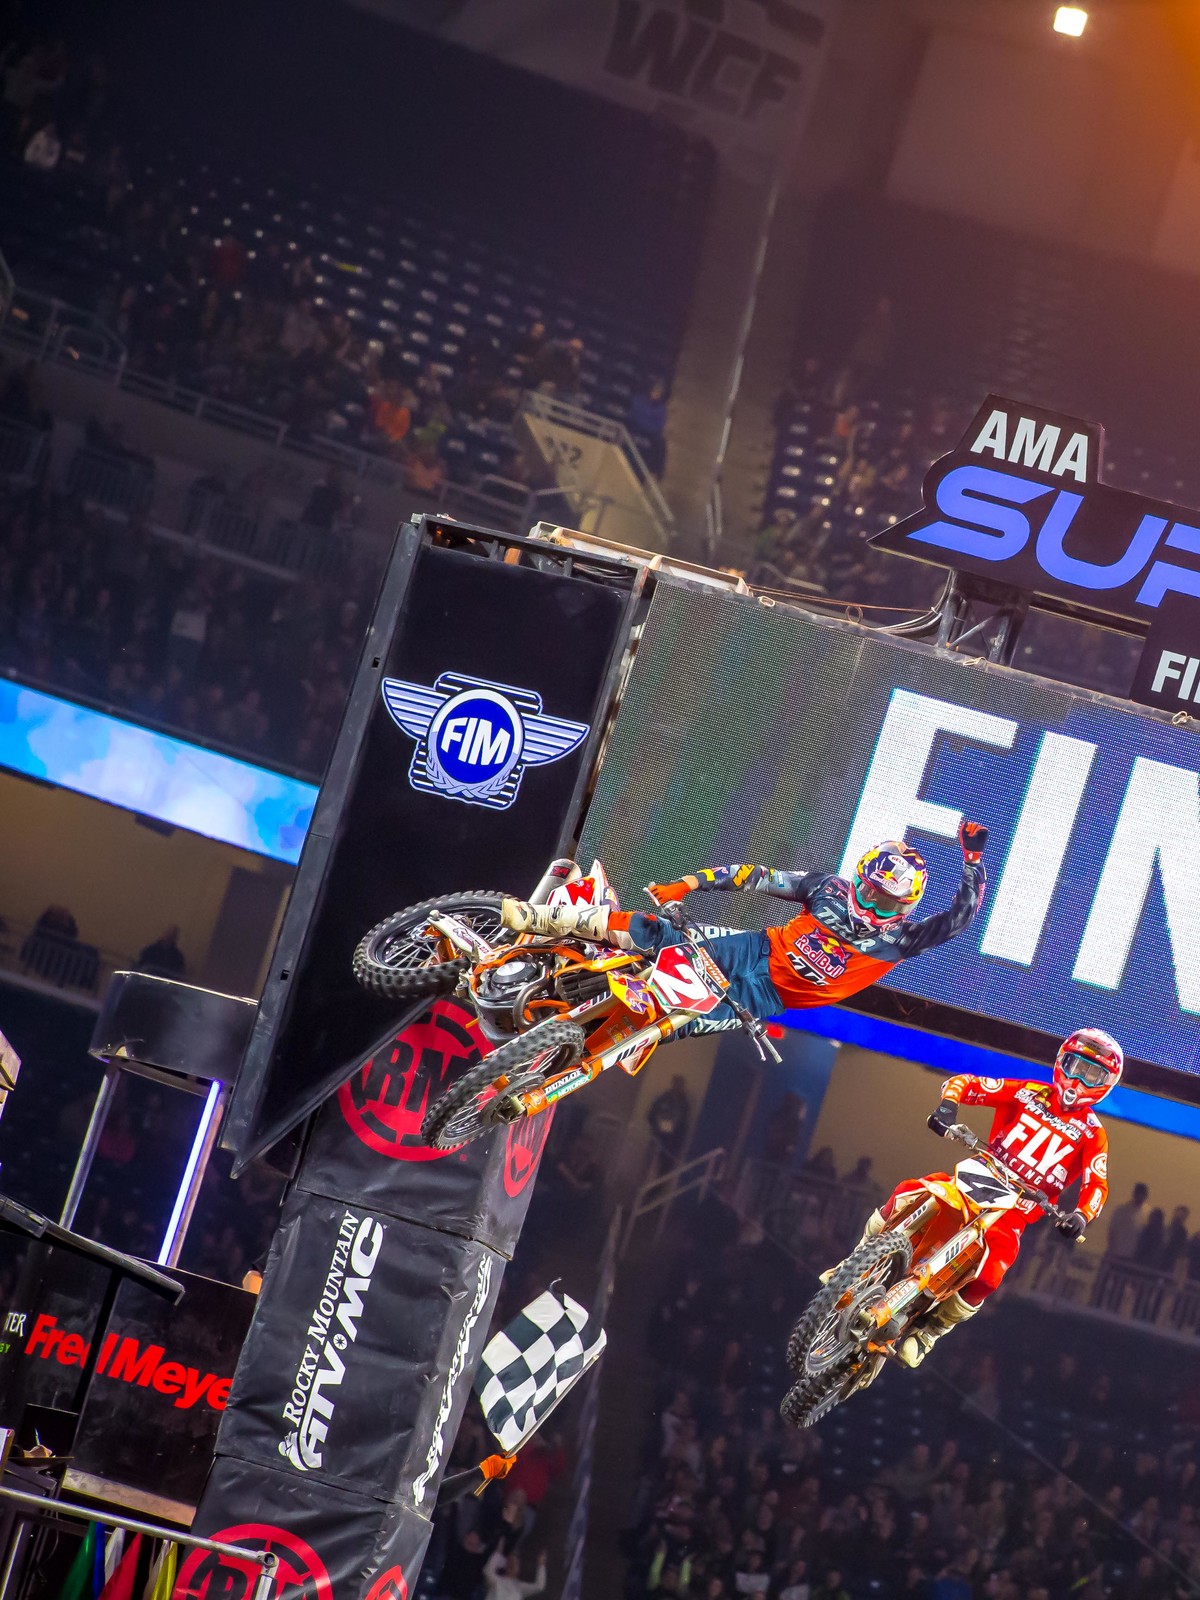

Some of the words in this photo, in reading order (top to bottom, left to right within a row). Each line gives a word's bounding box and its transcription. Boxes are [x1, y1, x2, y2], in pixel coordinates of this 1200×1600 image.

[970, 409, 1089, 483] AMA
[441, 717, 511, 766] FIM
[652, 963, 710, 1005] 2
[995, 1147, 1043, 1184] RACING
[283, 1343, 321, 1428] ROCKY
[307, 1210, 360, 1346] MOUNTAIN
